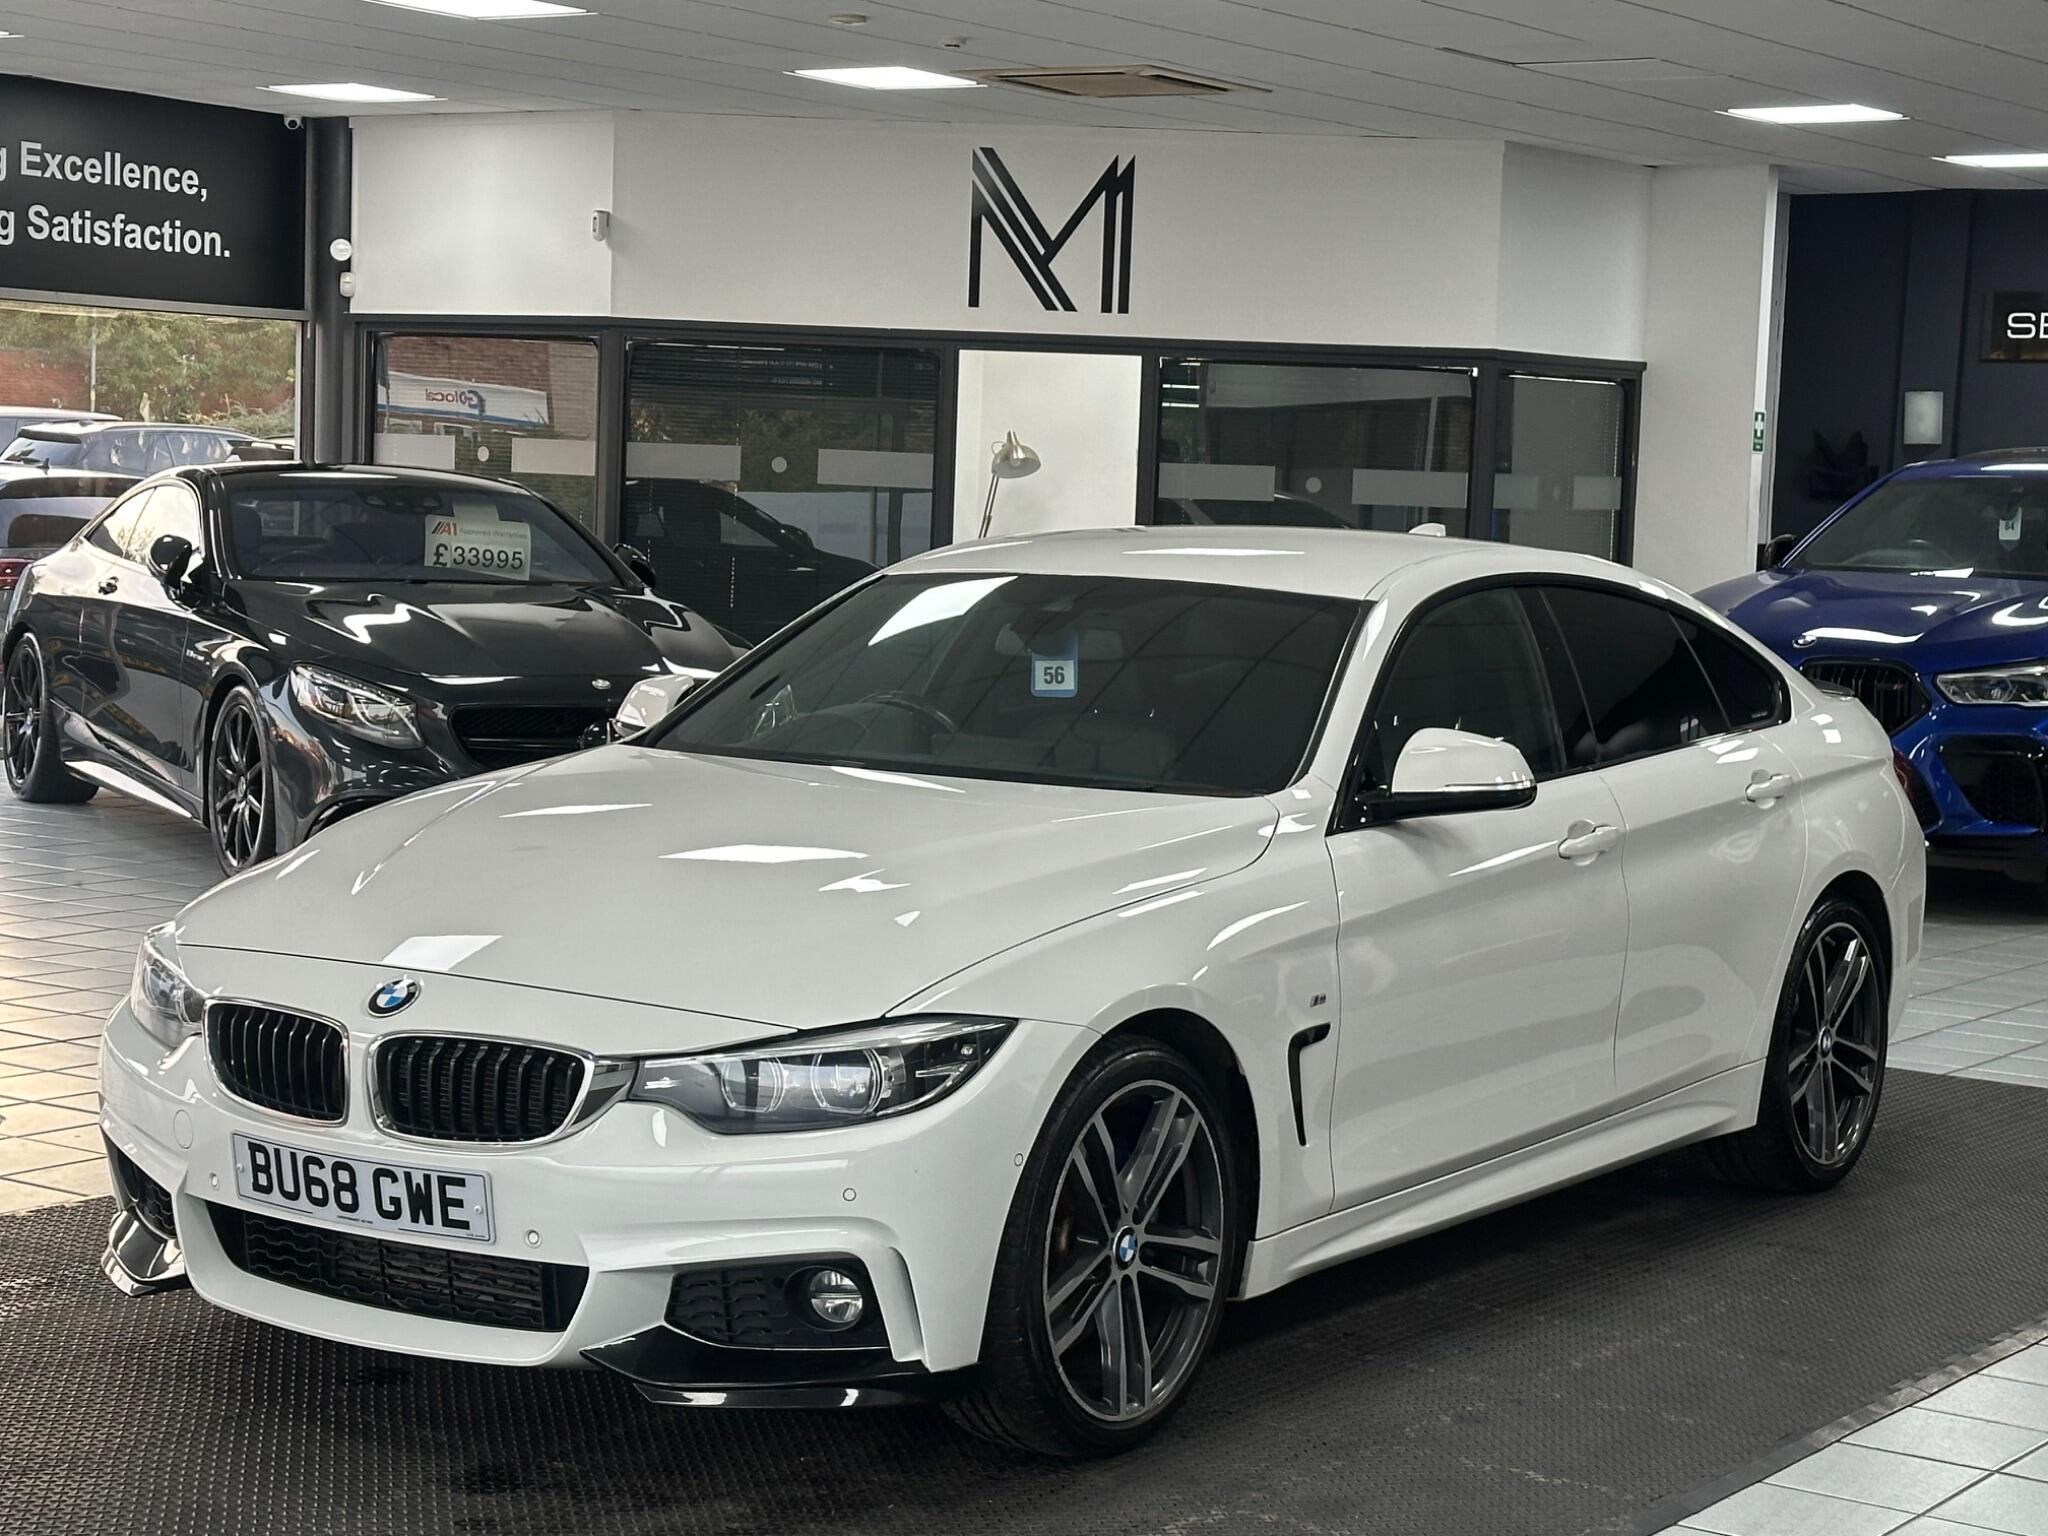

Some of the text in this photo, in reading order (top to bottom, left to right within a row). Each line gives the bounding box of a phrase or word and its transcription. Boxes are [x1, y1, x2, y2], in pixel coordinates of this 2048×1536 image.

[20, 140, 207, 202] Excellence,
[26, 204, 231, 258] Satisfaction.
[432, 543, 524, 570] £33995
[1043, 666, 1065, 684] 56
[247, 1140, 471, 1231] BU68 GWE
